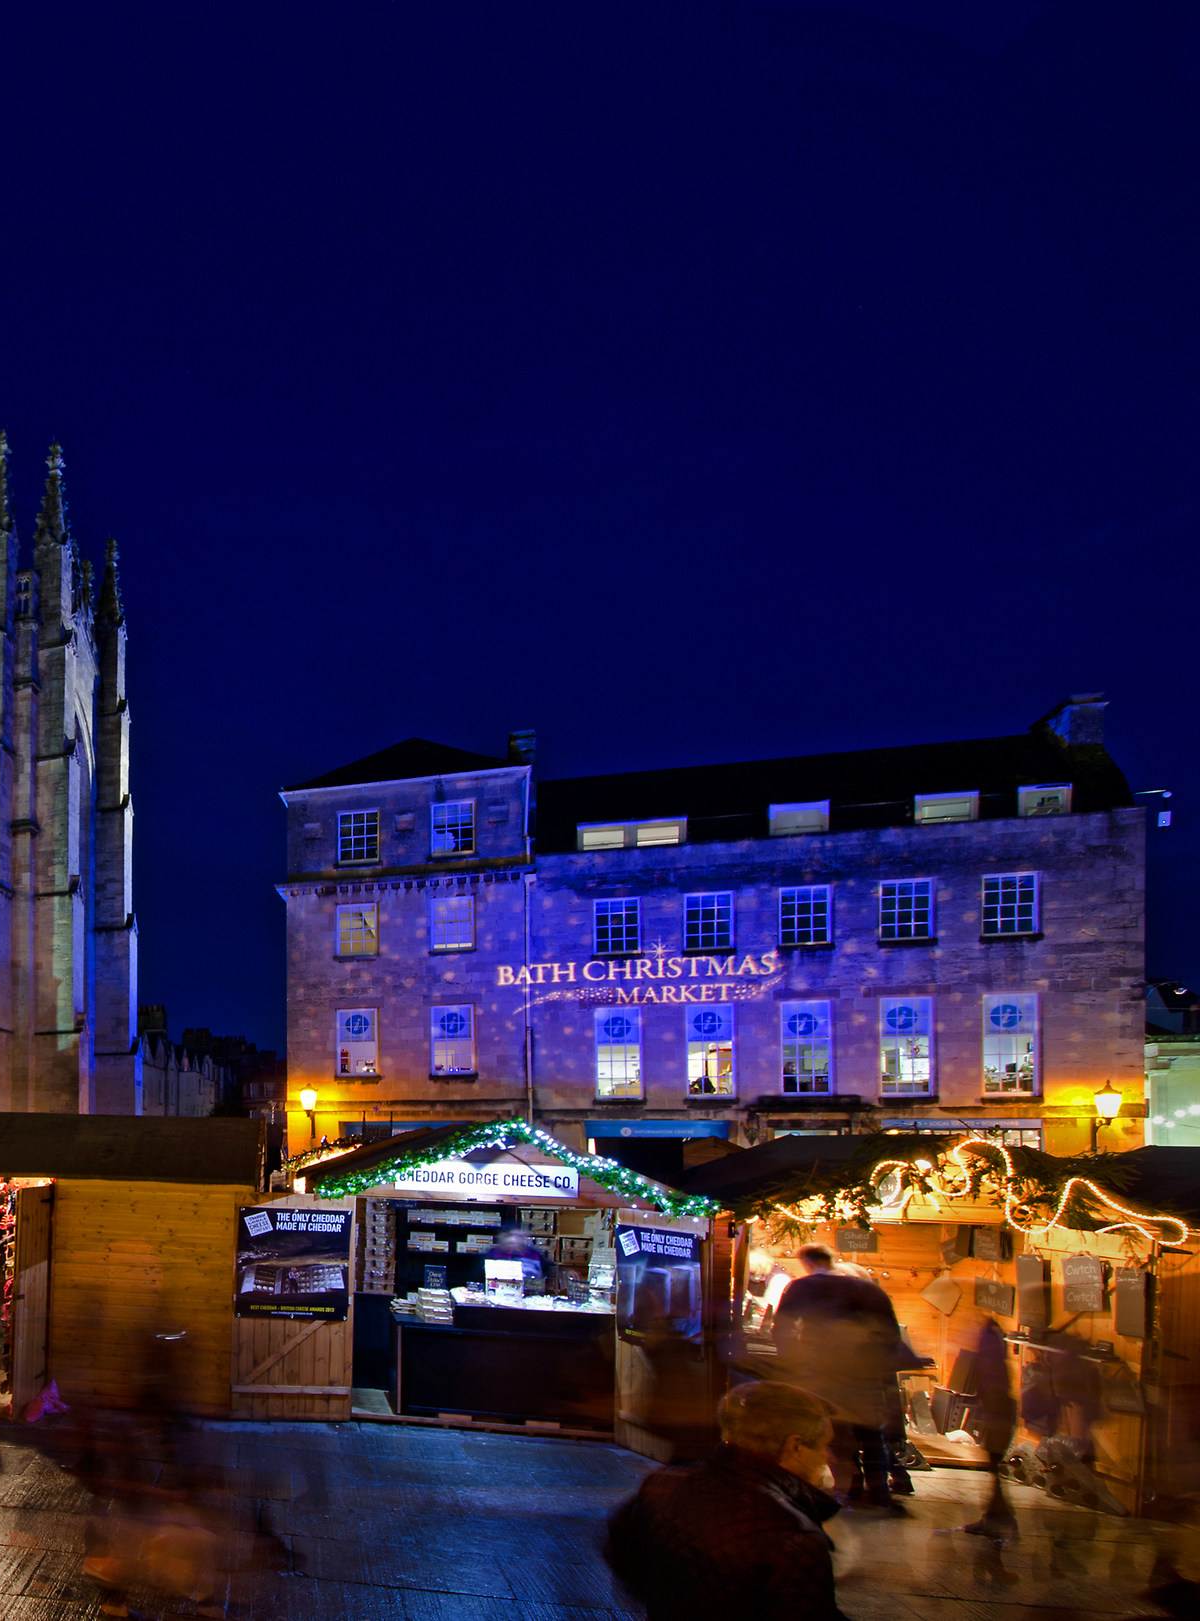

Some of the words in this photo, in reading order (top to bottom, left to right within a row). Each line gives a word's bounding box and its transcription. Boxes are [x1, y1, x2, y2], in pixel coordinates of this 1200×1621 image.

[497, 963, 577, 986] BATH
[582, 953, 778, 981] CHRISTMAS
[616, 983, 736, 1004] MARKET
[459, 1172, 499, 1186] GORGE
[503, 1174, 550, 1188] CHEESE
[554, 1176, 575, 1189] CO.
[276, 1213, 290, 1222] THE
[292, 1213, 310, 1222] ONLY
[311, 1214, 345, 1224] CHEDDAR
[276, 1222, 297, 1231] MADE
[298, 1223, 307, 1231] IN
[307, 1223, 342, 1233] CHEDDAR
[640, 1232, 650, 1241] THE
[651, 1233, 665, 1244] ONLY
[665, 1235, 693, 1248] CHEDDAR
[844, 1231, 870, 1241] Shed
[641, 1242, 656, 1253] MADE
[657, 1245, 663, 1254] IN
[664, 1245, 691, 1258] CHEDDAR
[847, 1241, 868, 1250] Taid
[1065, 1263, 1097, 1276] Cwtch
[1066, 1291, 1097, 1303] Cwtch
